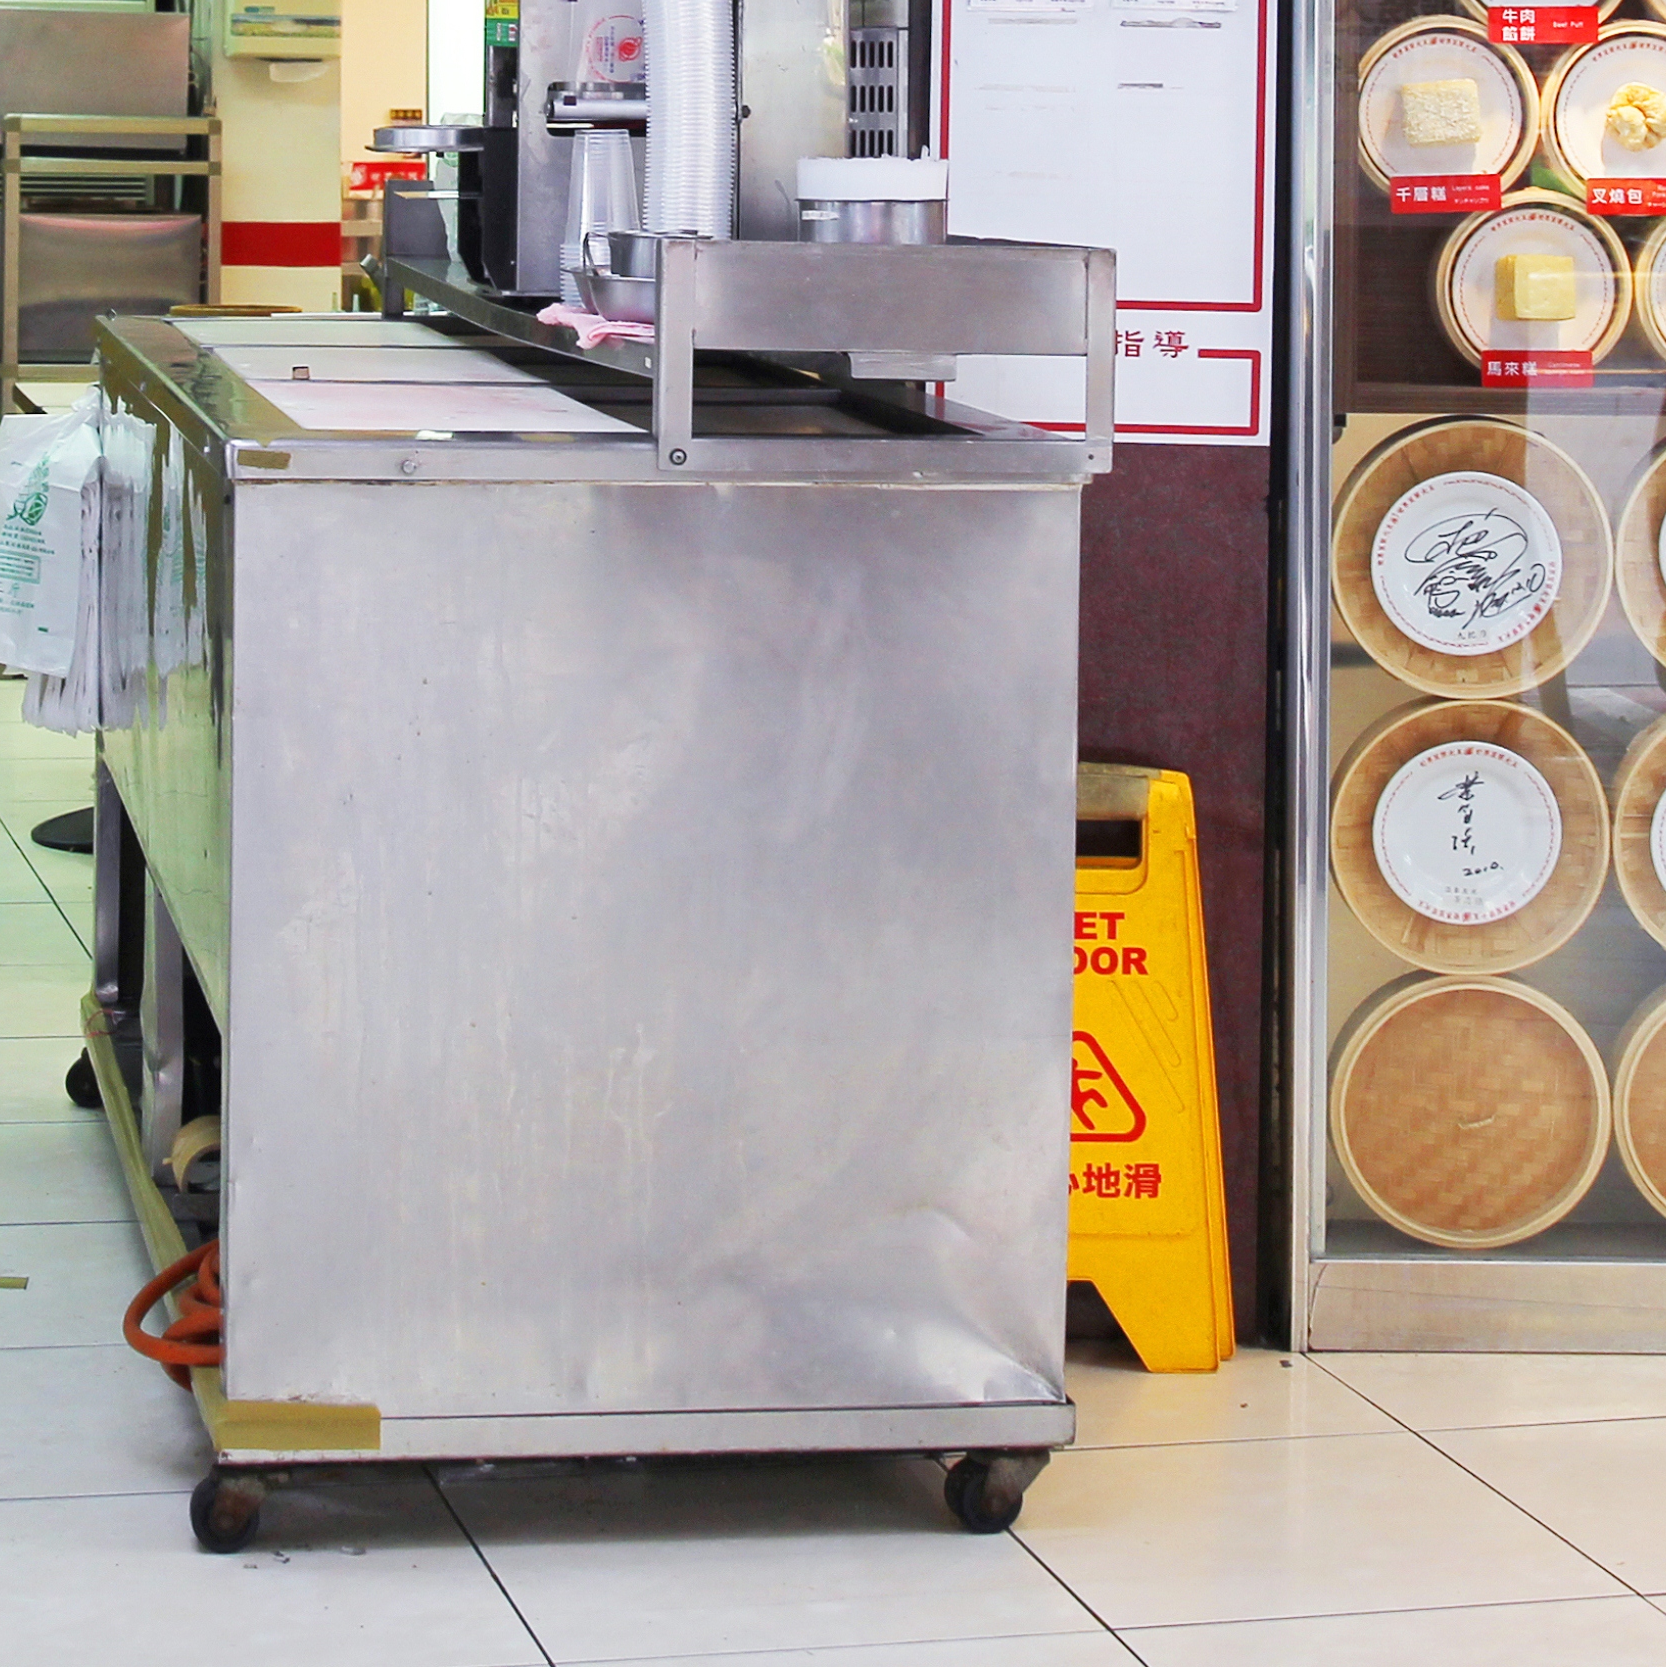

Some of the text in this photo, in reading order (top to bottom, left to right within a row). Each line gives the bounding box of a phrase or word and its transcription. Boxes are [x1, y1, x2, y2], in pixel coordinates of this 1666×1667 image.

[1501, 9, 1536, 24] 牛肉
[1590, 188, 1643, 205] 叉燒包
[1113, 329, 1190, 359] 指導
[1486, 361, 1538, 377] 馬來糕
[1074, 911, 1126, 939] ET
